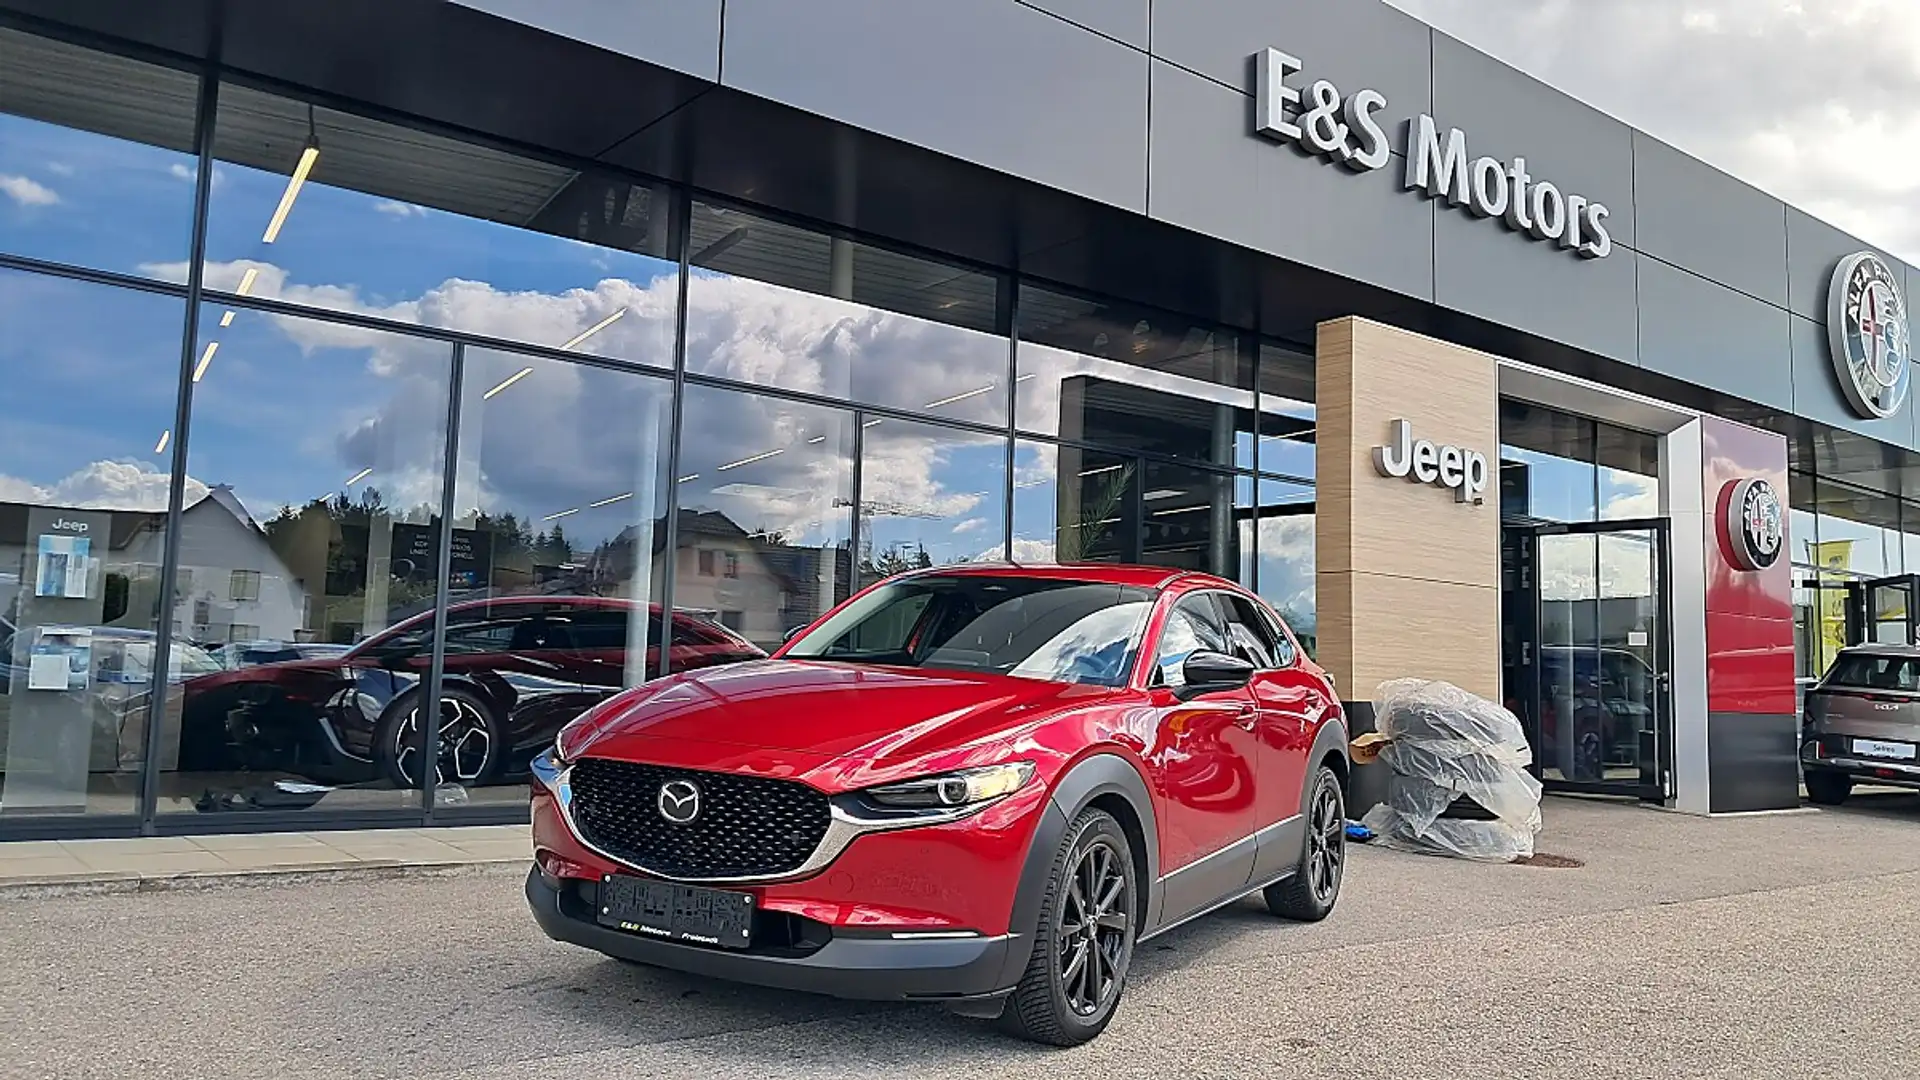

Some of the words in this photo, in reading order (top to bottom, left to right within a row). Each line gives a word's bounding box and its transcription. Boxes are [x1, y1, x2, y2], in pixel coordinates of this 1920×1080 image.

[1255, 46, 1391, 171] E&S
[1403, 113, 1612, 259] Motors
[1848, 265, 1872, 324] ALFA
[1372, 418, 1489, 504] Jeep
[52, 518, 88, 532] Jeep
